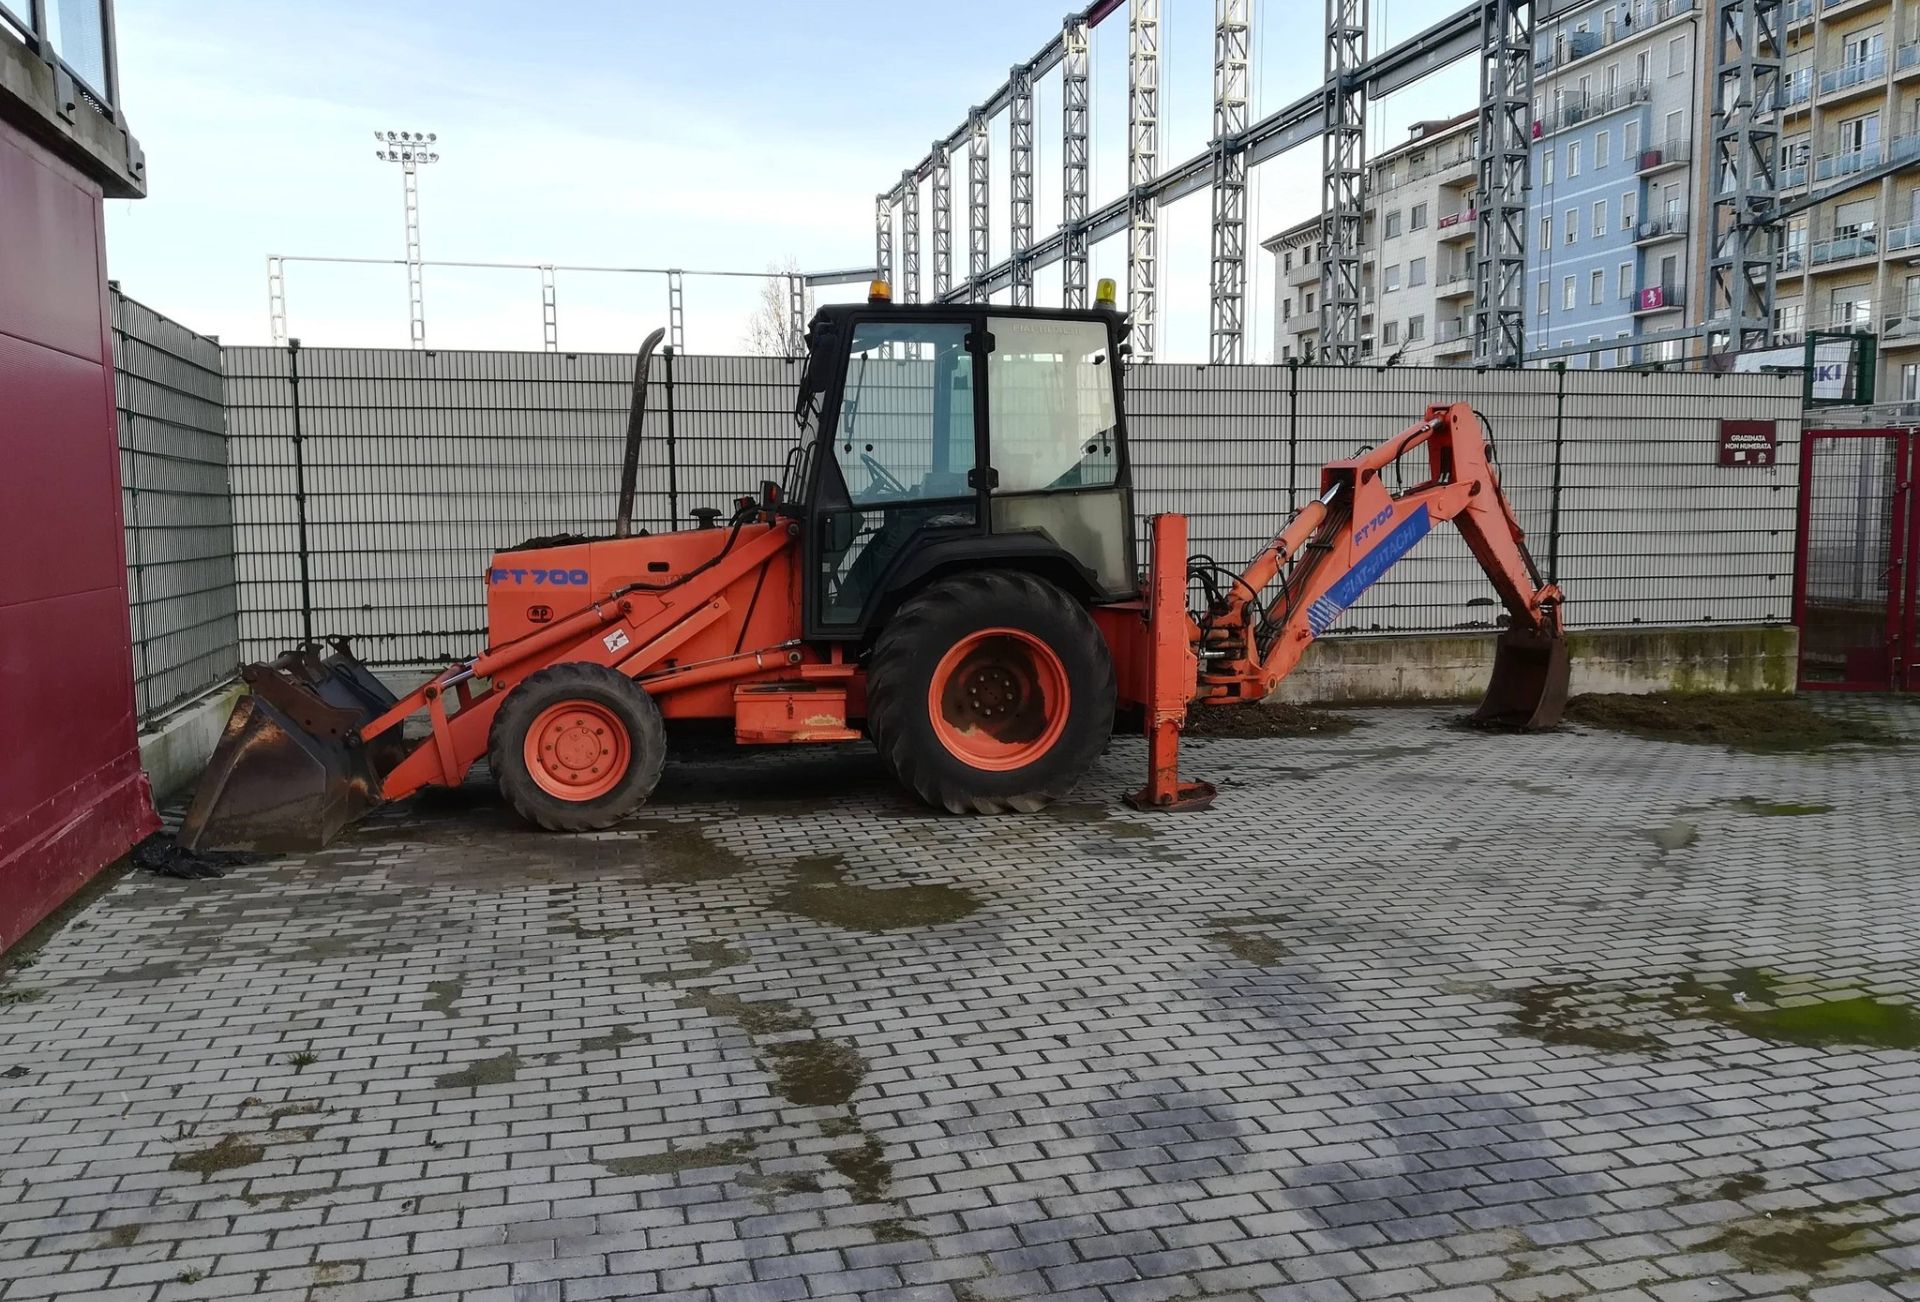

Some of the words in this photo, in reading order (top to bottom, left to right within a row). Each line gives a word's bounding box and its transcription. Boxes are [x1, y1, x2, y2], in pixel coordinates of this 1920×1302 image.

[1354, 525, 1369, 545] FT
[1373, 504, 1394, 532] 700
[492, 569, 528, 584] FT
[531, 569, 589, 585] 700
